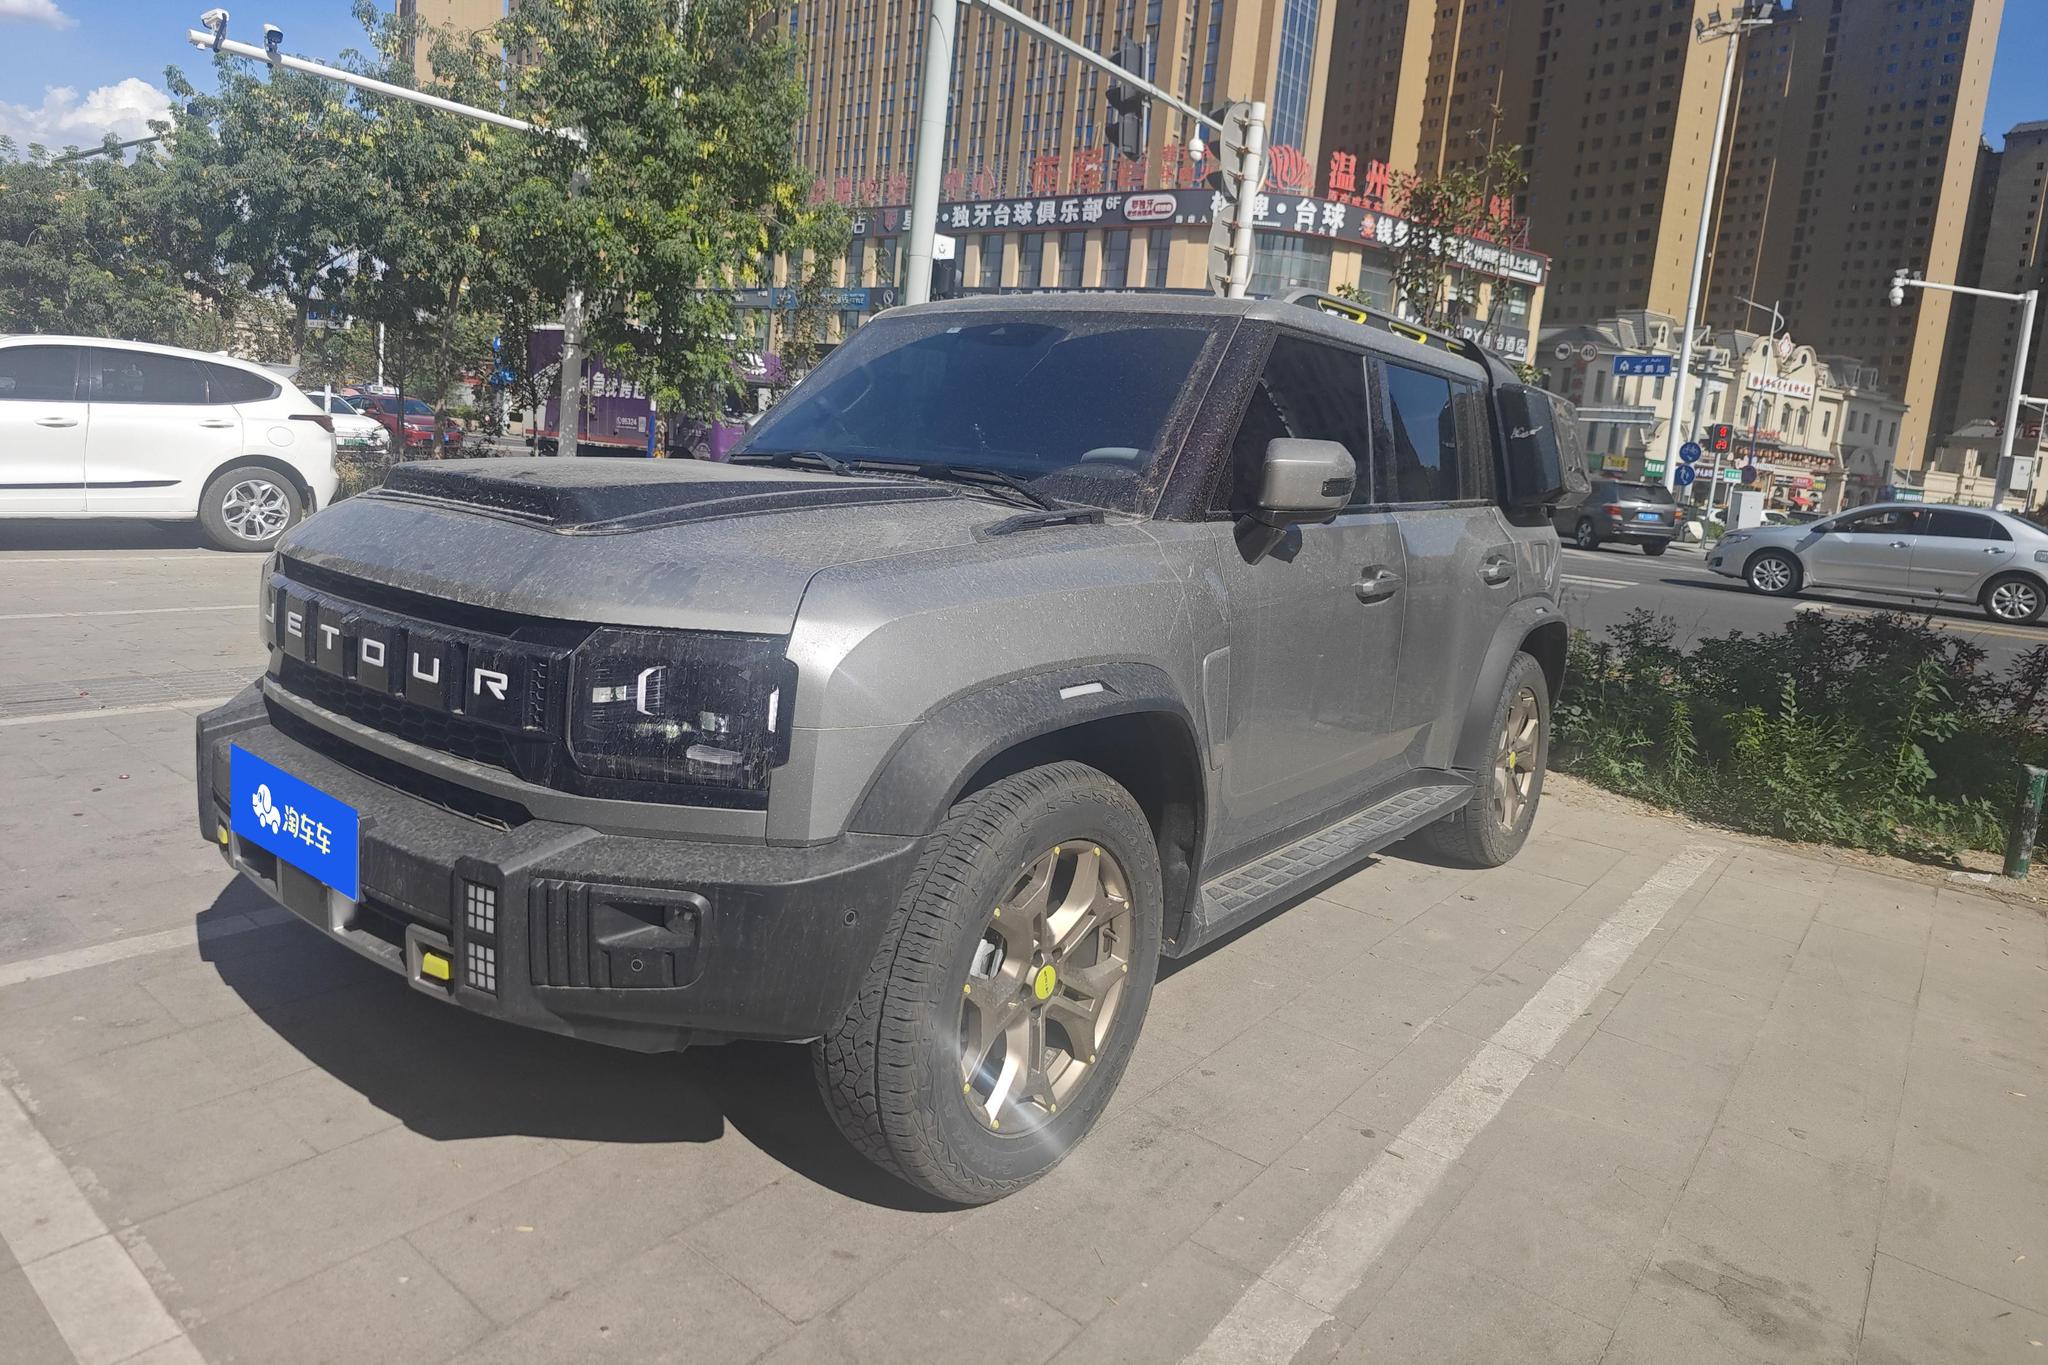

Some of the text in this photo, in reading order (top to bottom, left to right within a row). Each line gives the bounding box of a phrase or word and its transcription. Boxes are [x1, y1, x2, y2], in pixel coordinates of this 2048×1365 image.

[1105, 196, 1121, 211] 6F
[1582, 348, 1595, 357] 40
[265, 602, 509, 700] JETOUR
